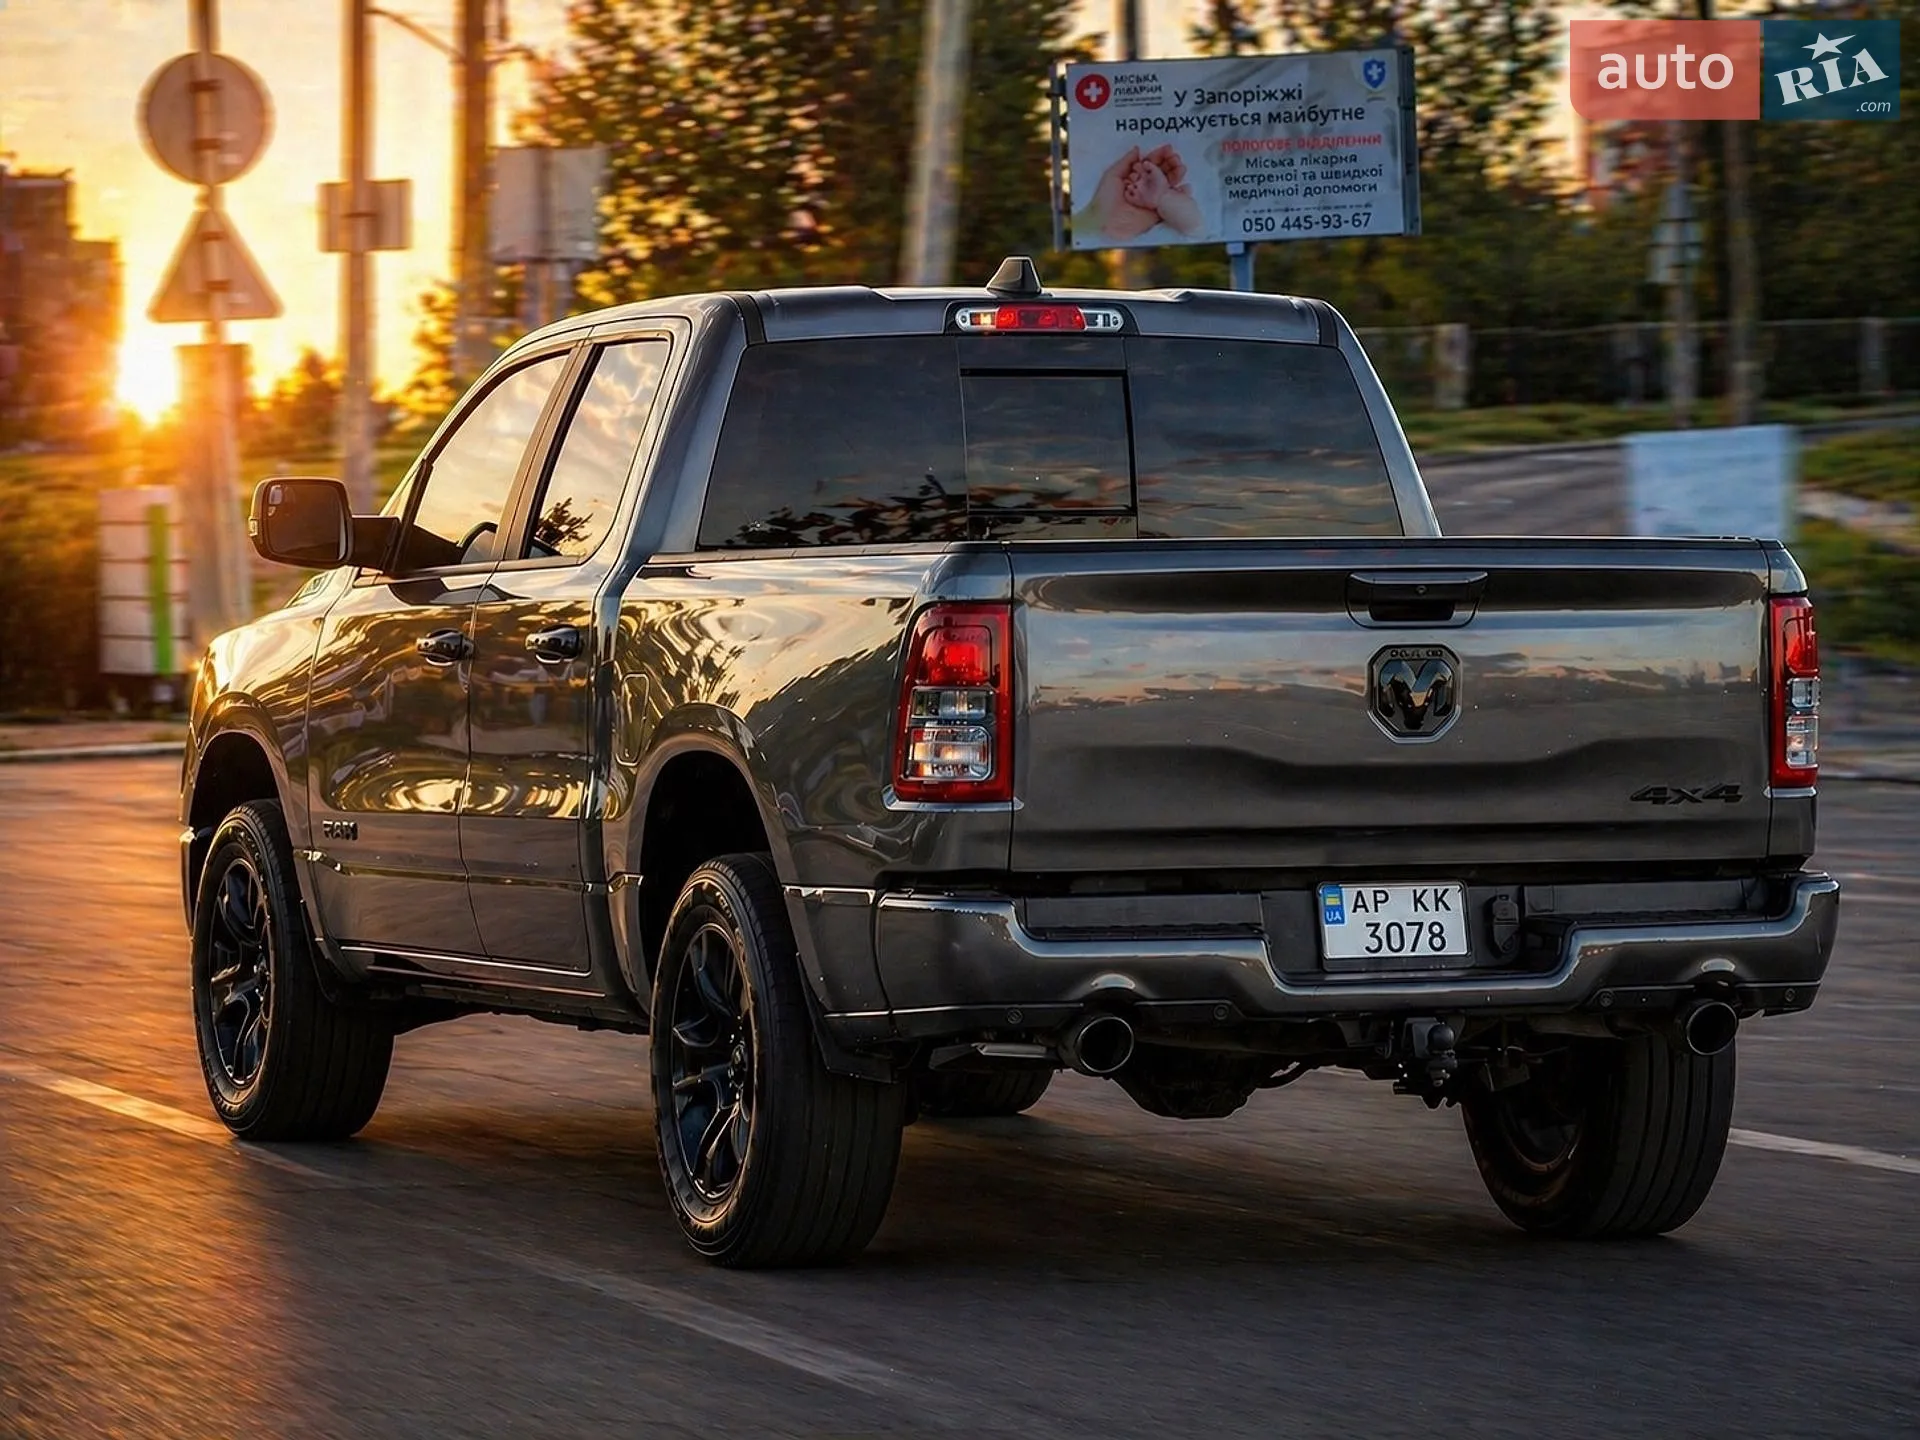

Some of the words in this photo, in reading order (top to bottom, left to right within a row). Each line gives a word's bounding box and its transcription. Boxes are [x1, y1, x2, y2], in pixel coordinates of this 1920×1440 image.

[1194, 84, 1303, 107] Запоріжжі
[1115, 111, 1261, 135] народжується
[1267, 106, 1365, 125] майбутне
[1245, 156, 1295, 169] Міська
[1300, 153, 1358, 167] лікарня
[1224, 170, 1298, 186] екстреної
[1302, 169, 1317, 181] та
[1320, 163, 1383, 180] швидкої
[1228, 187, 1299, 200] медичної
[1303, 182, 1378, 198] допомоги
[1242, 217, 1276, 233] 050
[1281, 212, 1372, 230] 445-93-67
[1326, 911, 1342, 922] UA
[1365, 921, 1447, 954] 3078
